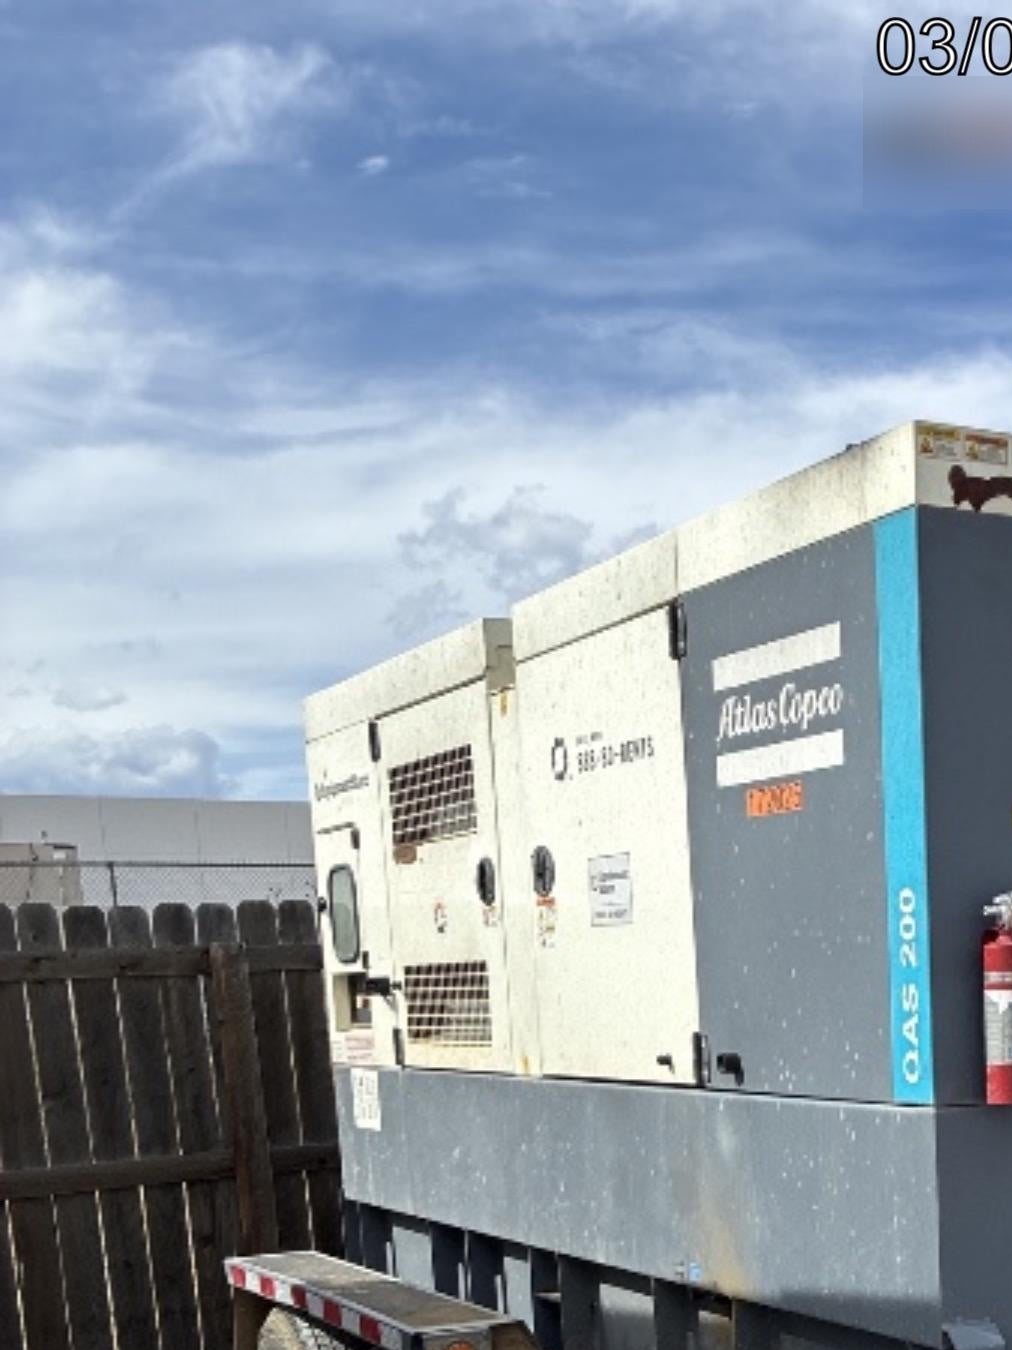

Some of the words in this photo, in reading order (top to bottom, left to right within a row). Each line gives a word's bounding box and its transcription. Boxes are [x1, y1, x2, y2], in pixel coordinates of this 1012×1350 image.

[715, 693, 778, 749] Atlas
[779, 682, 844, 730] Copco
[899, 888, 916, 967] 200
[902, 983, 920, 1083] QAS
